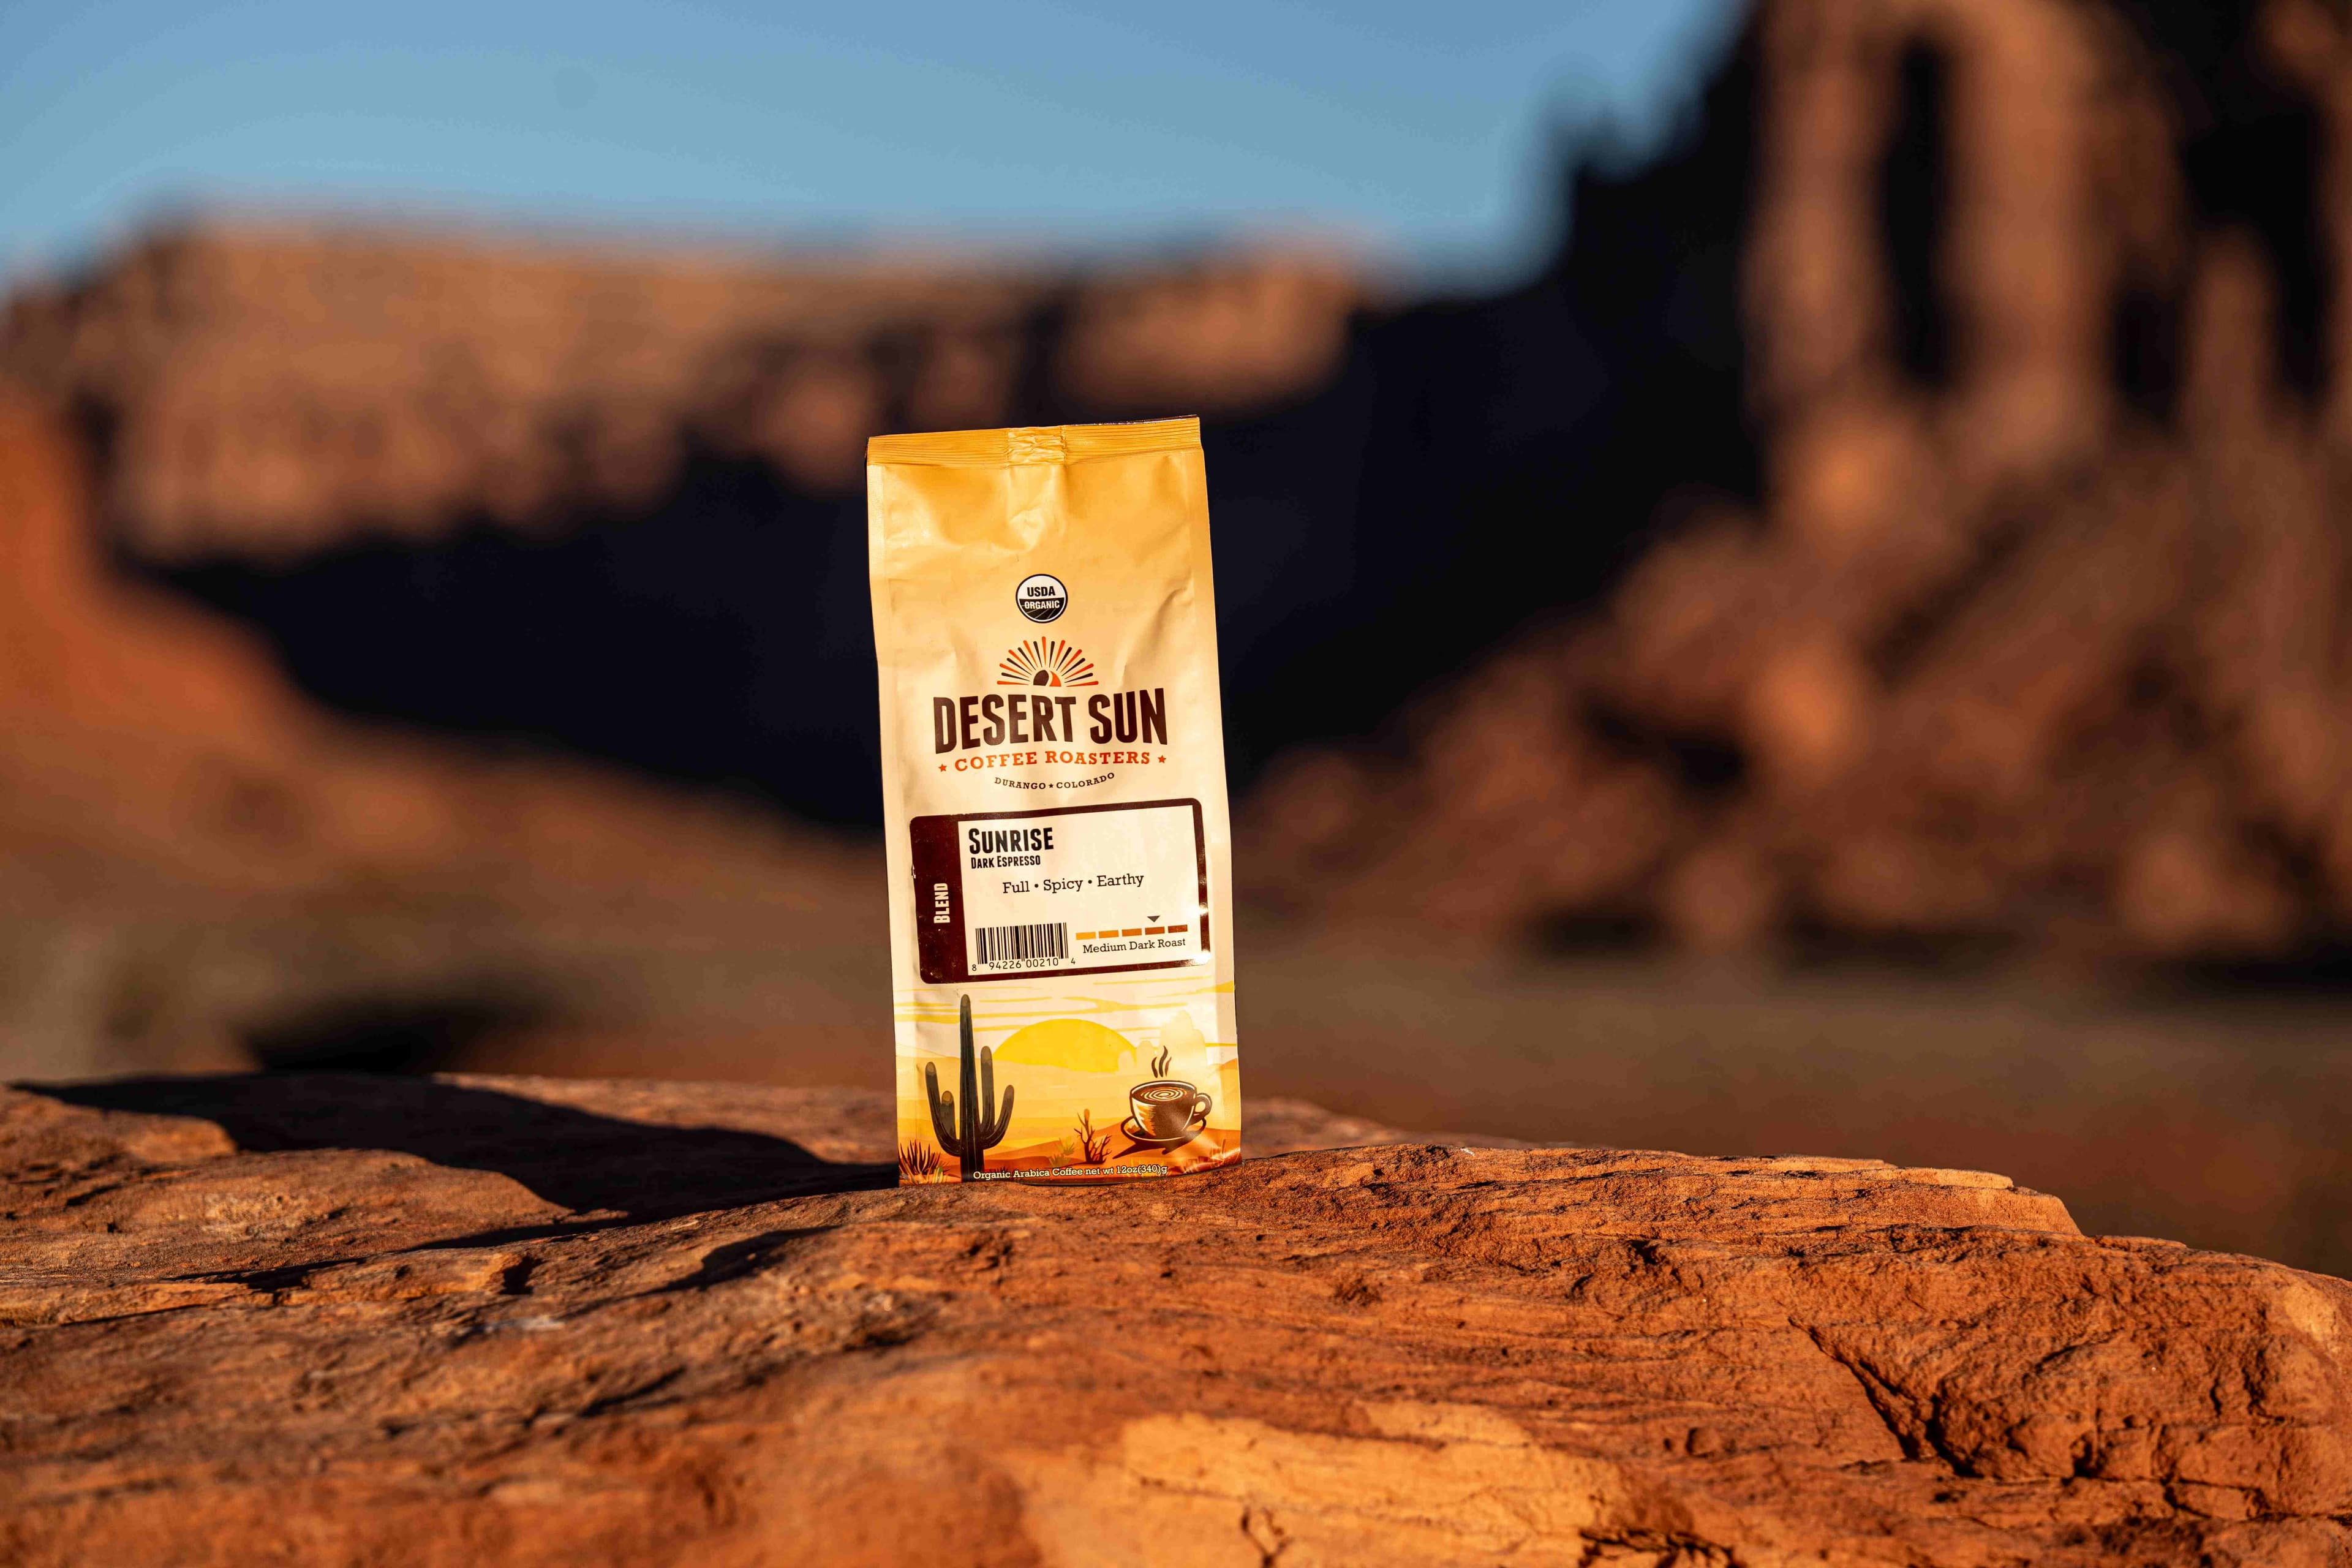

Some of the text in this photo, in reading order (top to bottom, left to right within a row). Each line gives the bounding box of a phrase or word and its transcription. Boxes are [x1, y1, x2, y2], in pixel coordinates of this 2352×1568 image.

[1027, 586, 1056, 598] USDA
[1023, 599, 1060, 610] ORGANIC
[933, 688, 1168, 754] DESERT SUN
[954, 751, 1150, 772] COFFEE ROASTERS
[994, 772, 1115, 790] DURANGO COLORADO
[1003, 873, 1144, 894] Full Spicy Earthy
[1083, 938, 1186, 954] Medium Dark Roast
[989, 960, 1022, 970] 94226
[1025, 958, 1059, 968] 00210
[973, 1170, 1011, 1181] Organic
[1012, 1169, 1050, 1178] Arabica
[1052, 1167, 1083, 1176] Coffee
[1085, 1166, 1101, 1175] net
